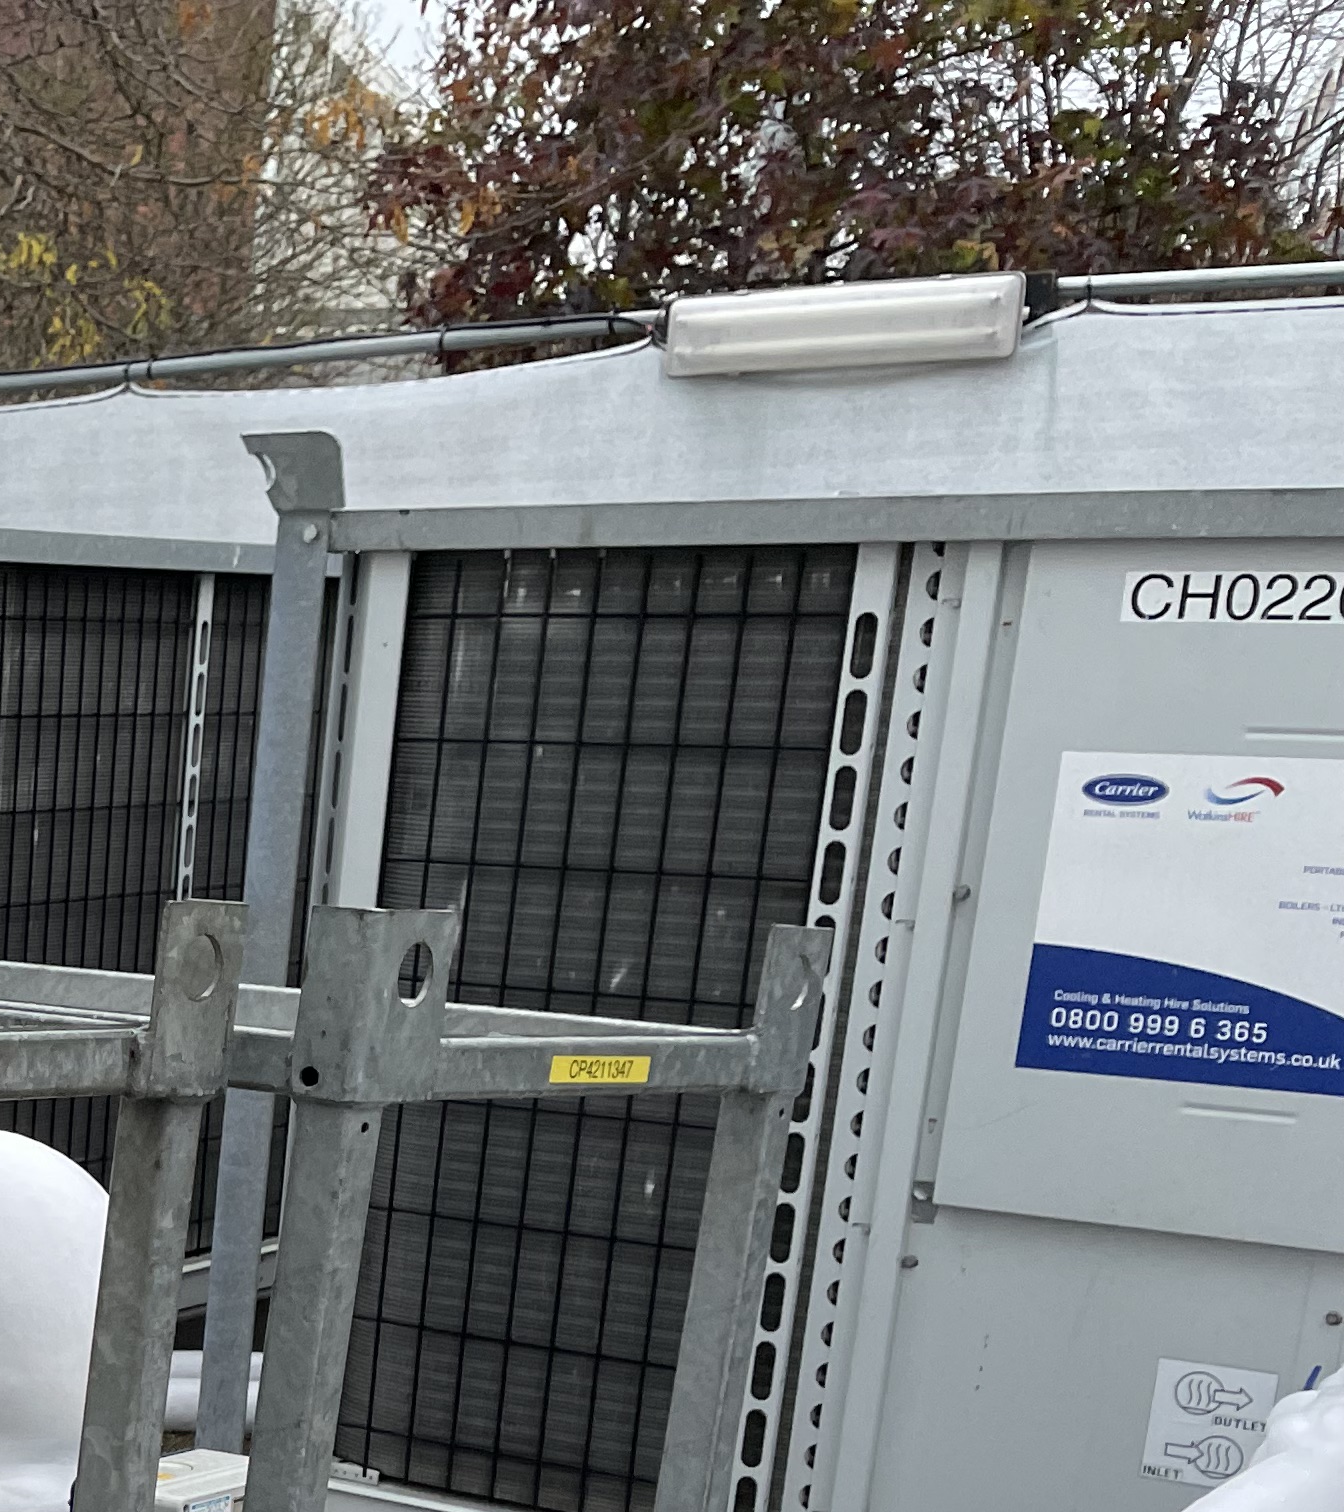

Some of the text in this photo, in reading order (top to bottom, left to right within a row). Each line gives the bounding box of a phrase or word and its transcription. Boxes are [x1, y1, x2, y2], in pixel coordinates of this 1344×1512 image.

[1131, 573, 1344, 621] CH022
[1094, 781, 1159, 797] Carrier
[1054, 989, 1250, 1014] Cooling & Heating Hire Solutions
[1050, 1007, 1268, 1044] 0800 999 6 365
[1047, 1032, 1342, 1069] www.carrierrentalsystems.co.uk
[568, 1059, 635, 1079] CP4211347
[1214, 1416, 1266, 1432] OUTLET
[1143, 1465, 1180, 1480] INLET
